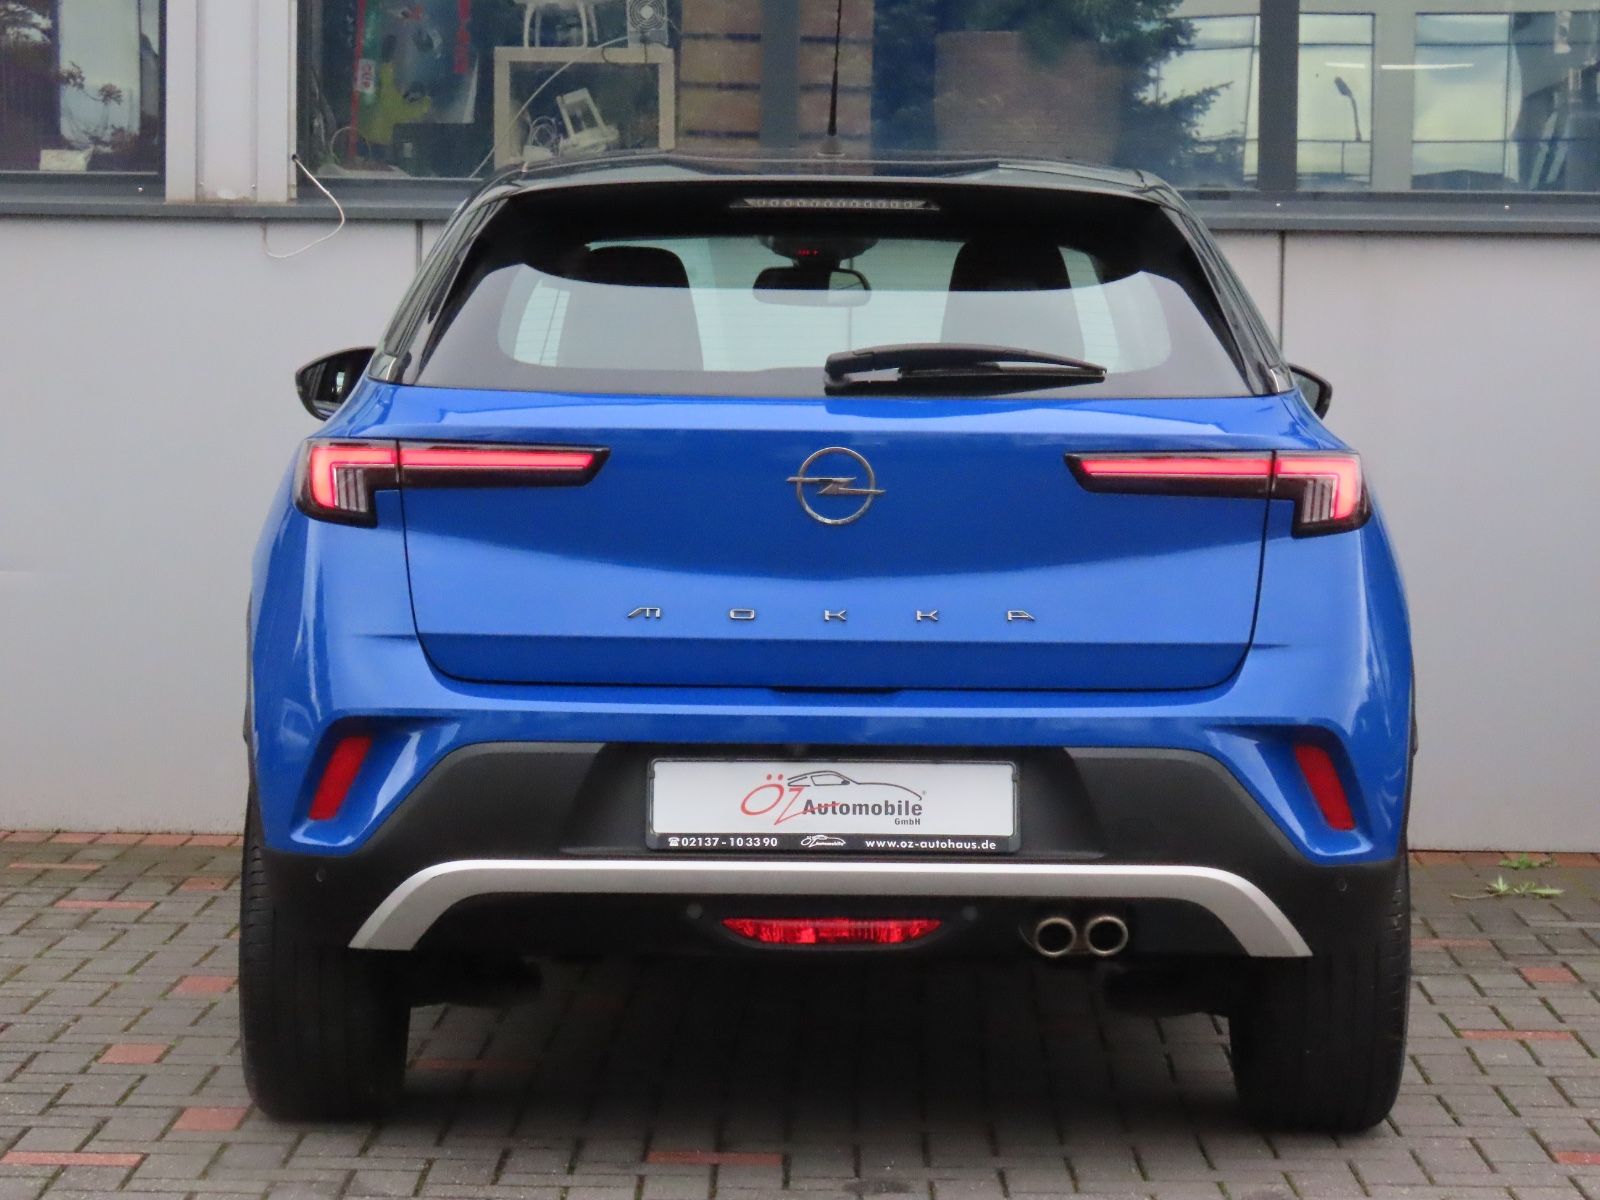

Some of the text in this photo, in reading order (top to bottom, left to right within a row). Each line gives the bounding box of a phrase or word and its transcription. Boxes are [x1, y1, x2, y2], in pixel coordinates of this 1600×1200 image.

[627, 606, 1036, 622] MOKKA
[802, 798, 923, 816] Automobile
[894, 817, 921, 826] GmbH
[865, 839, 997, 850] www.oz-autohaus.de
